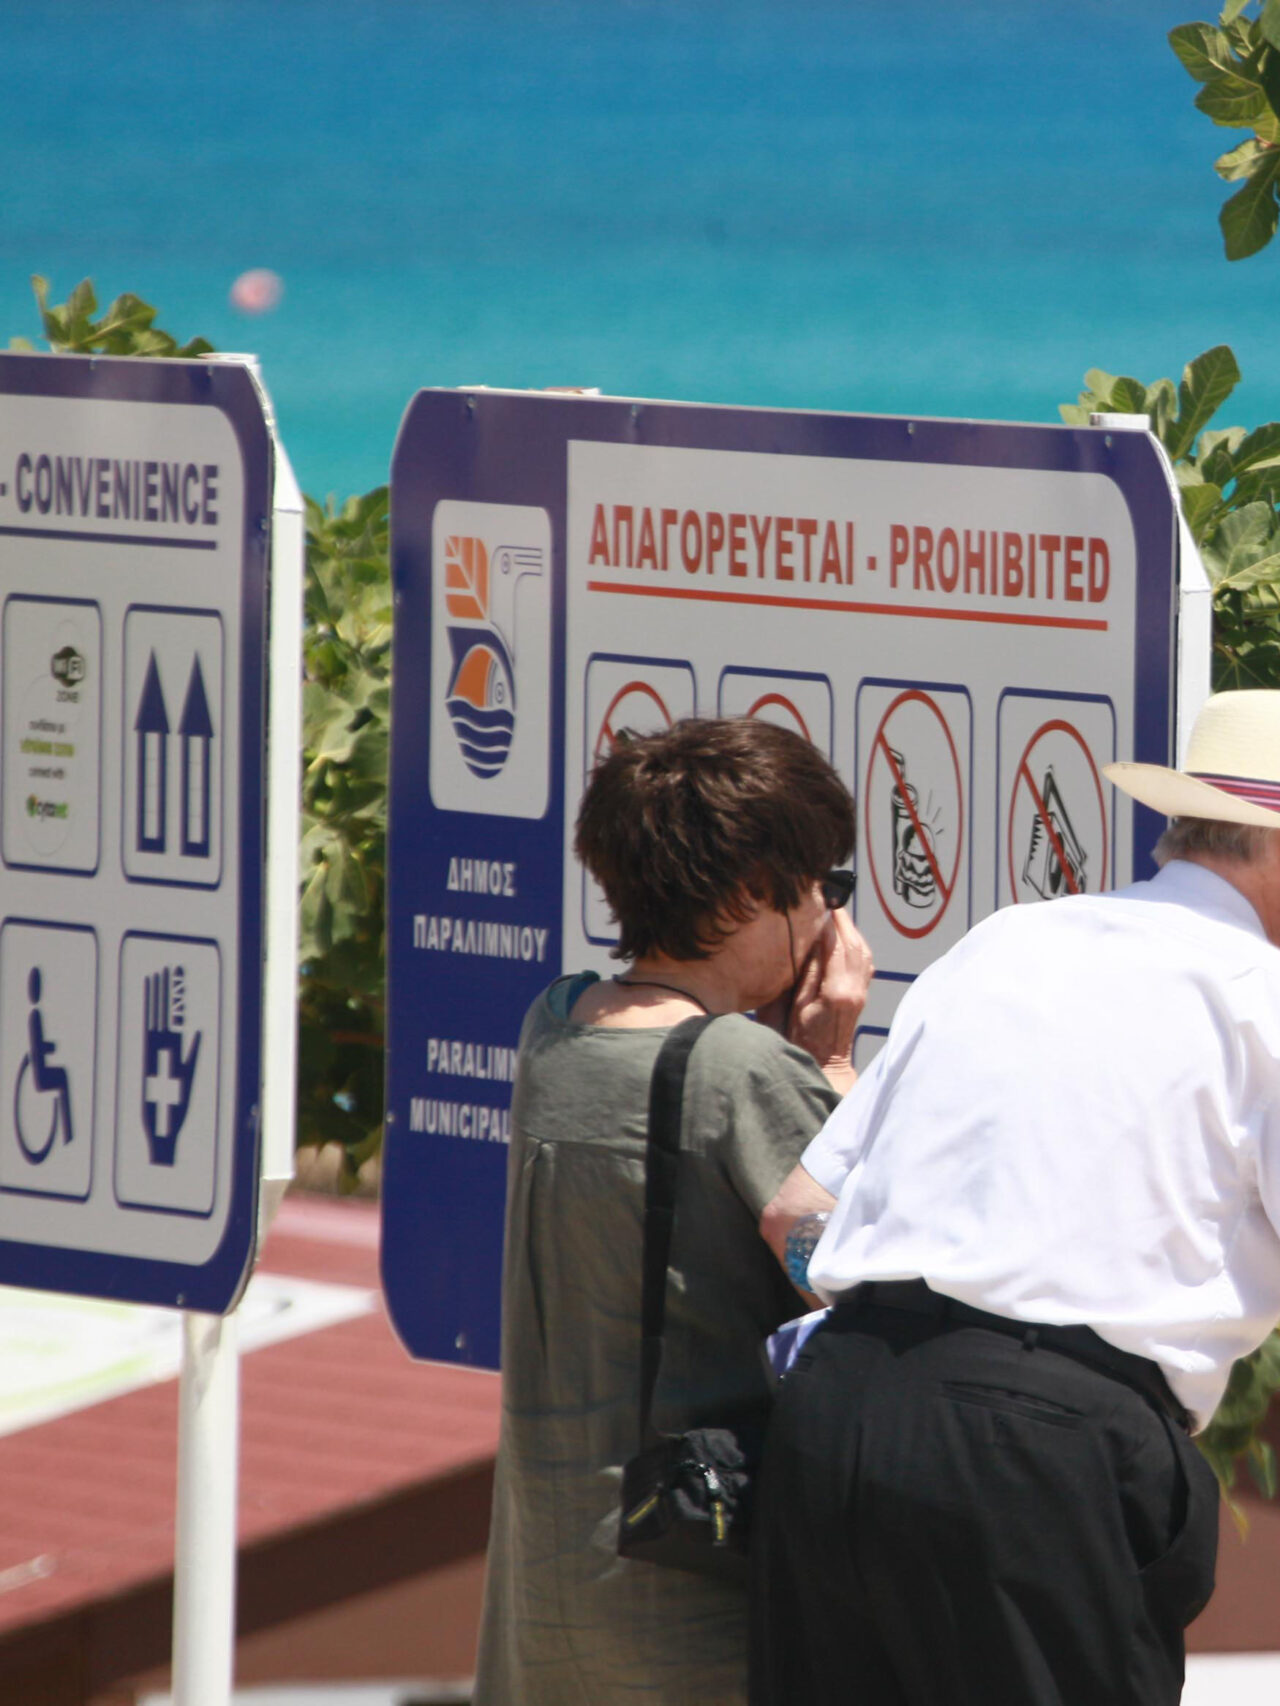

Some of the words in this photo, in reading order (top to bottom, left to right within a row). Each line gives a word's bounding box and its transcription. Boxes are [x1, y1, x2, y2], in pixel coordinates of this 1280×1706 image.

[15, 453, 218, 526] CONVENIENCE
[588, 503, 854, 585] ΑΠΑΓΟΡΕΥΕΤΑΙ
[890, 524, 1110, 603] PROHIBITED
[446, 857, 515, 897] ΔΗΜΟΣ
[413, 914, 548, 963] ΠΑΡΑΛΙΜΝΙΟΥ
[427, 1038, 518, 1083] PARALIMN
[409, 1097, 511, 1144] MUNICIPAL
